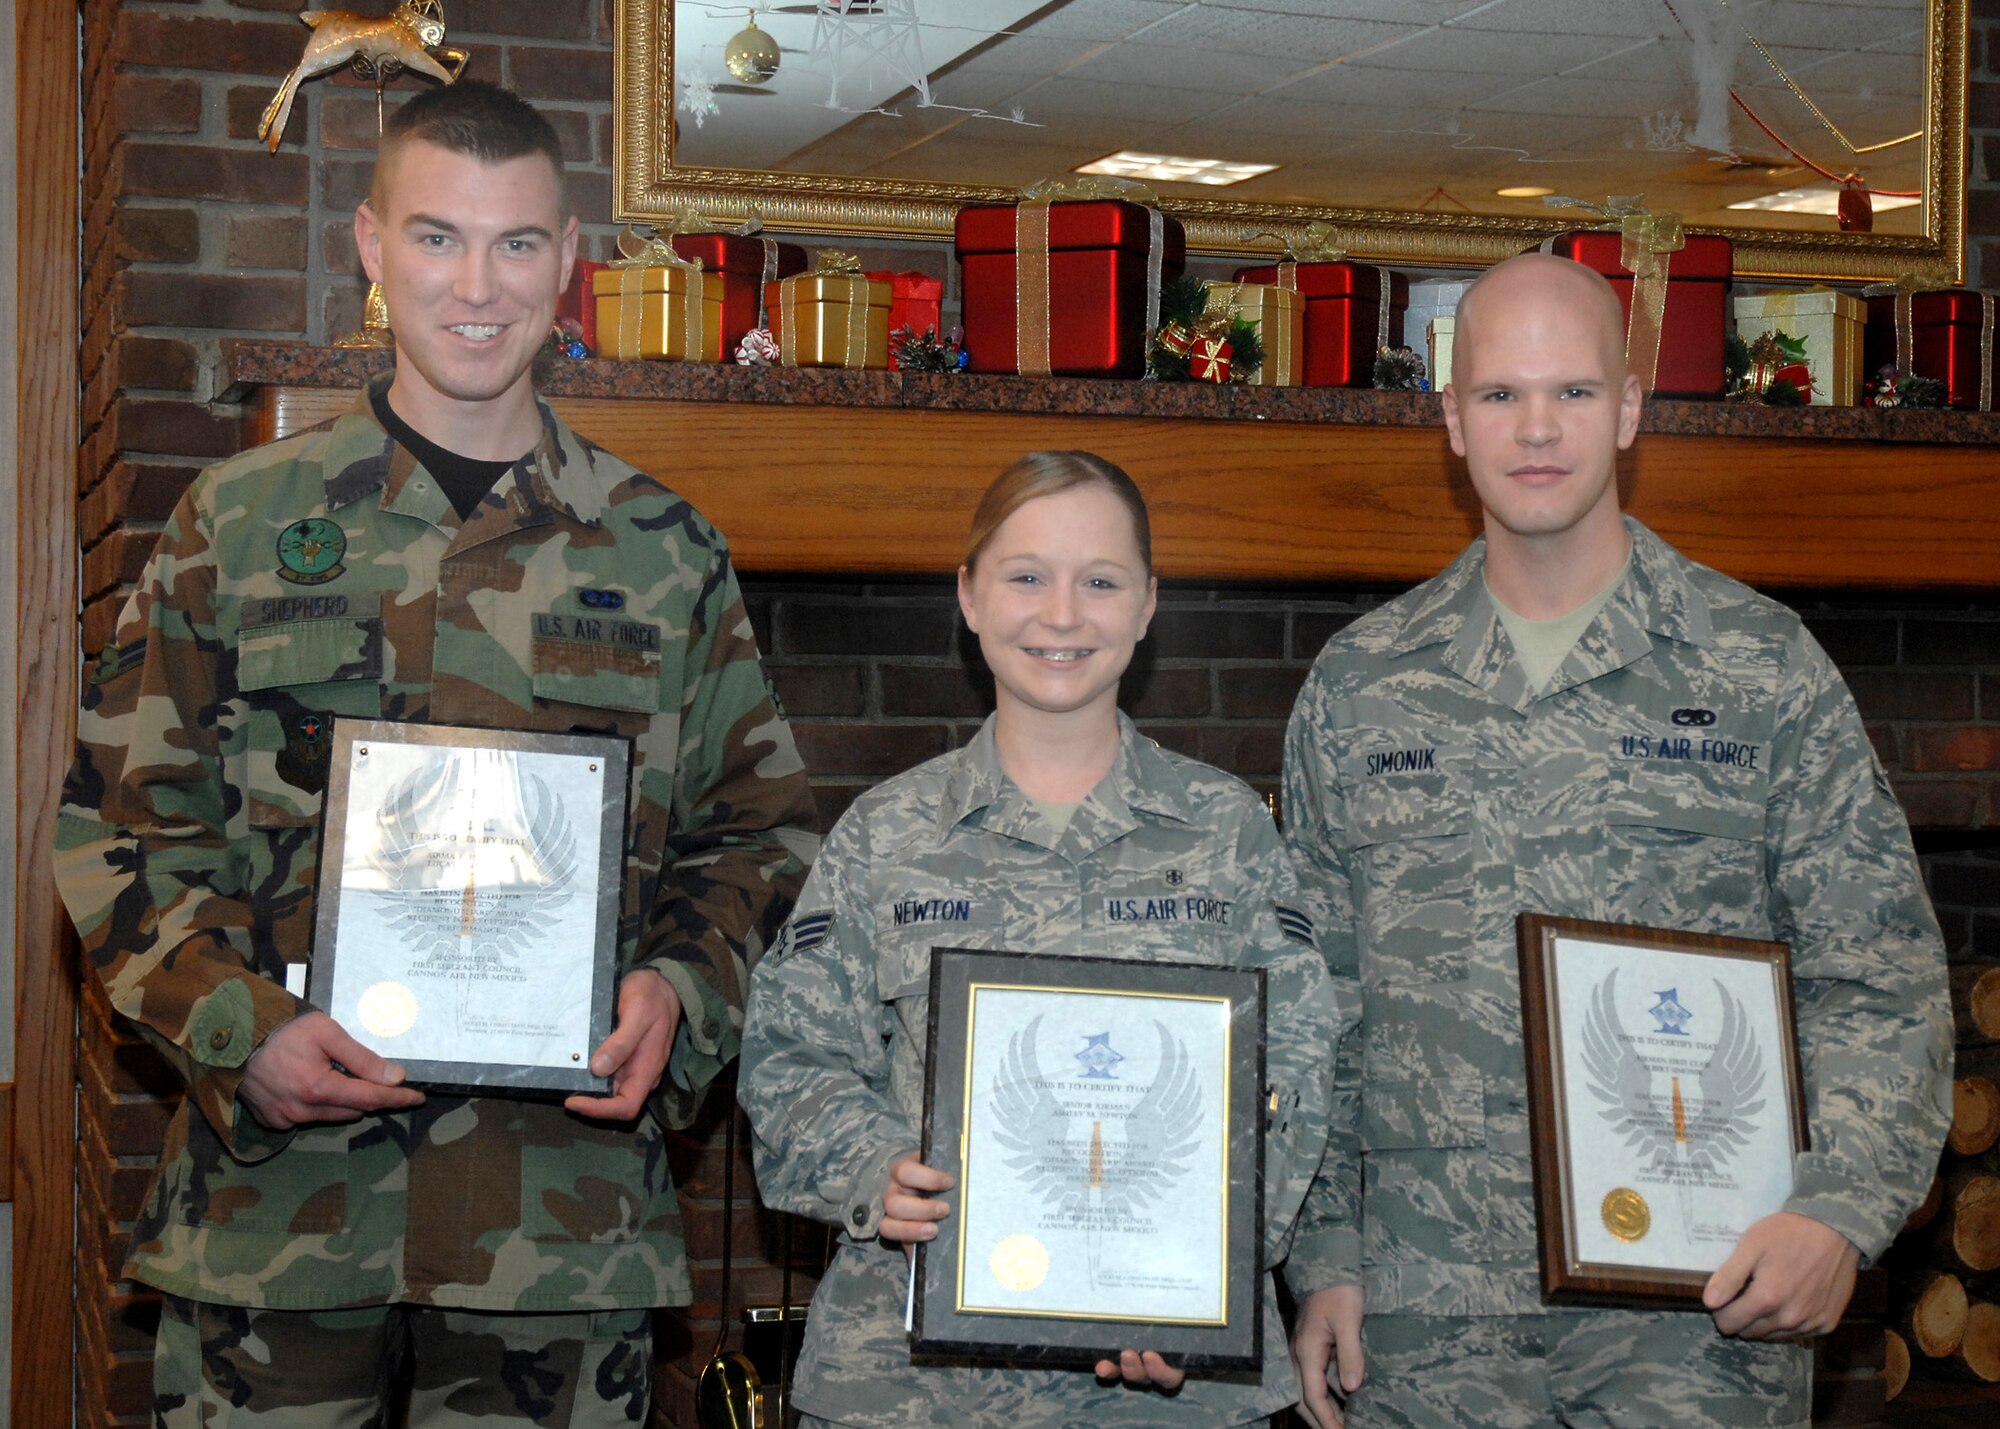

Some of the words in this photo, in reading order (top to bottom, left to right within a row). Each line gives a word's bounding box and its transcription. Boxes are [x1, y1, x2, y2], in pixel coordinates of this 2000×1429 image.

[262, 596, 349, 624] SHEPHERD
[537, 615, 567, 637] U.S.
[575, 618, 602, 641] AIR
[611, 620, 658, 649] FORCE
[1366, 748, 1435, 776] SIMONIK
[1621, 735, 1654, 758] U.S.
[1657, 737, 1691, 761] AIR
[1701, 740, 1760, 770] FORCE
[893, 899, 970, 926] NEWTON
[1109, 899, 1142, 921] U.S.
[1145, 898, 1177, 920] AIR
[1185, 898, 1231, 925] FORCE
[407, 969, 447, 978] CANNON
[492, 974, 528, 983] MEXICO
[483, 964, 523, 974] COUNCIL
[1617, 1033, 1636, 1043] THIS
[1647, 1036, 1659, 1045] TO
[1660, 1038, 1693, 1049] CERTIFY
[1695, 1042, 1718, 1052] THAT
[1034, 1081, 1055, 1090] THIS
[1069, 1082, 1082, 1090] TO
[1083, 1083, 1121, 1092] CERTIFY
[1126, 1085, 1153, 1094] THAT
